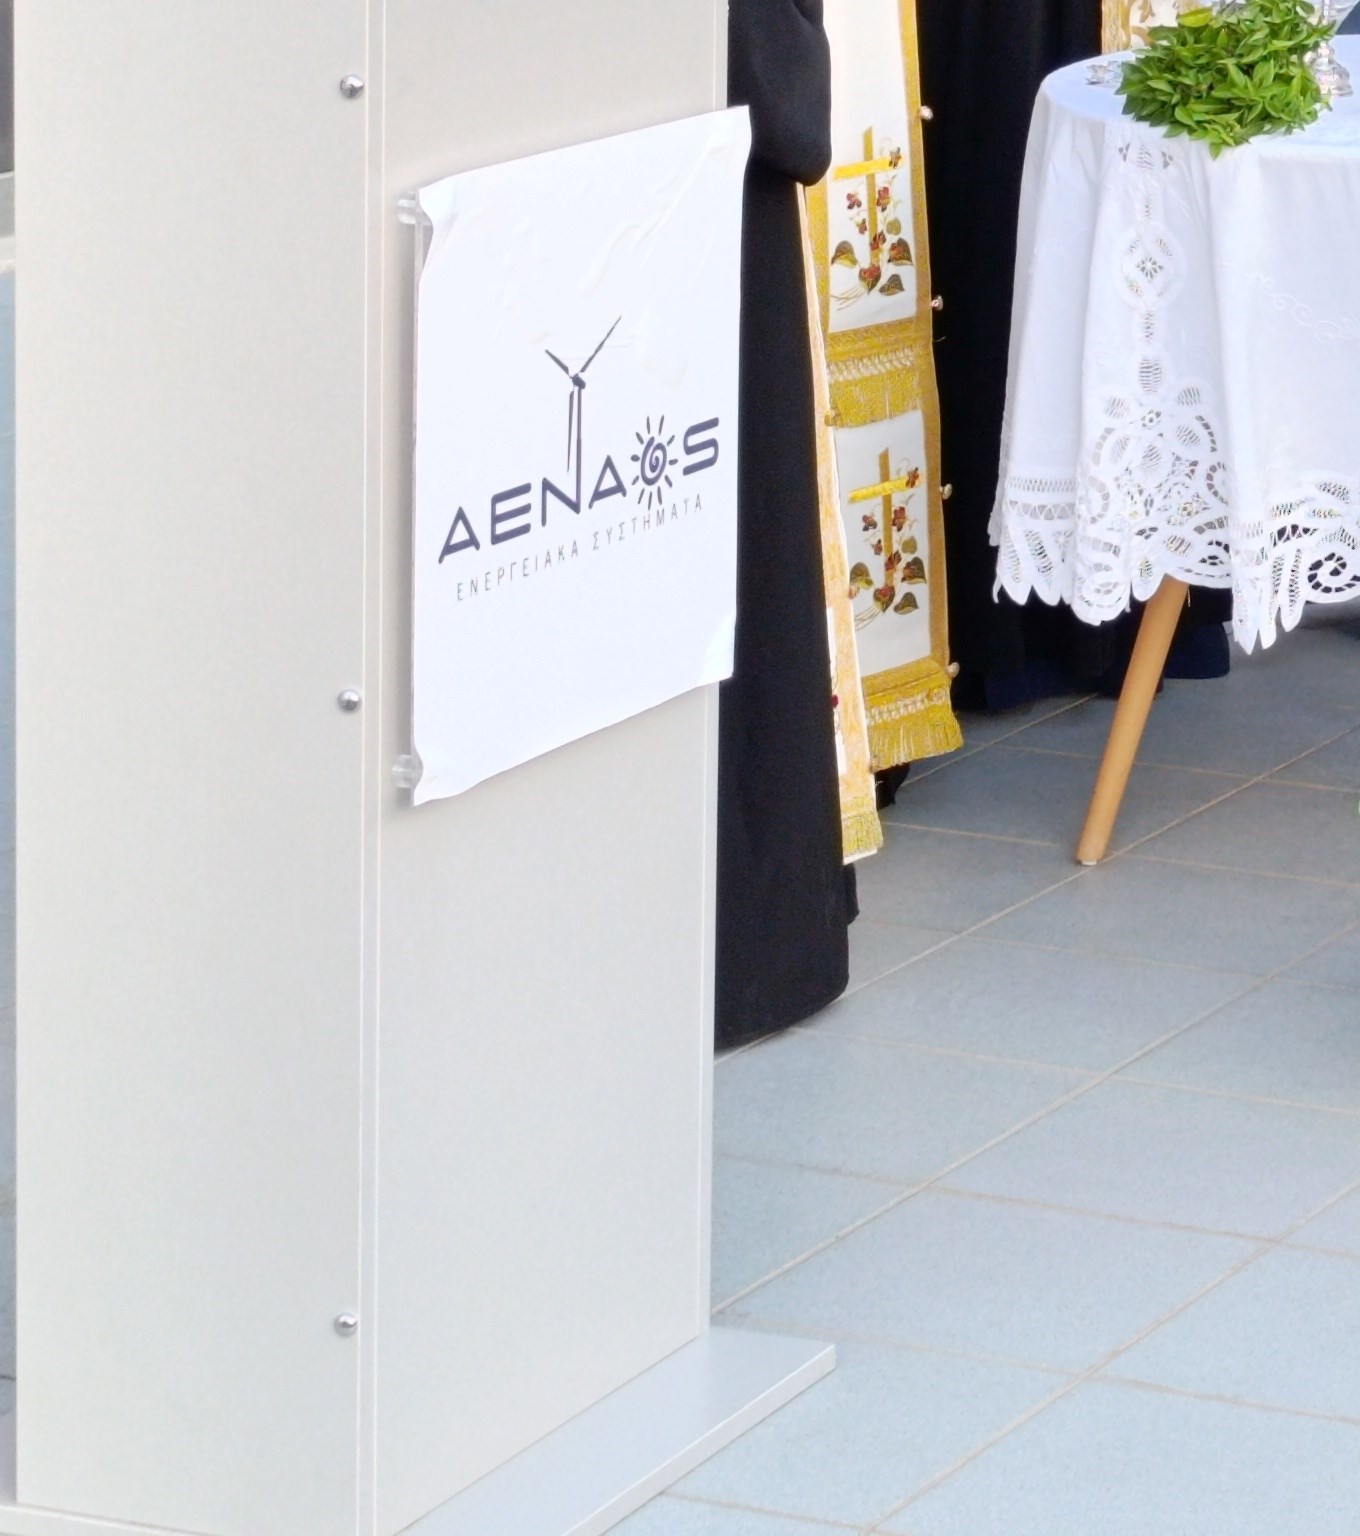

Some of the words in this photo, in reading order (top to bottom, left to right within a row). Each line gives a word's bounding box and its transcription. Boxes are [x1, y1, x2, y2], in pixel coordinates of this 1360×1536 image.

[437, 415, 720, 565] AENAOS
[456, 538, 580, 602] ΕΝΕΡΓΕΙΑΚΑ
[592, 493, 703, 551] ΣΥΣΤΗΜΑΤΑ
